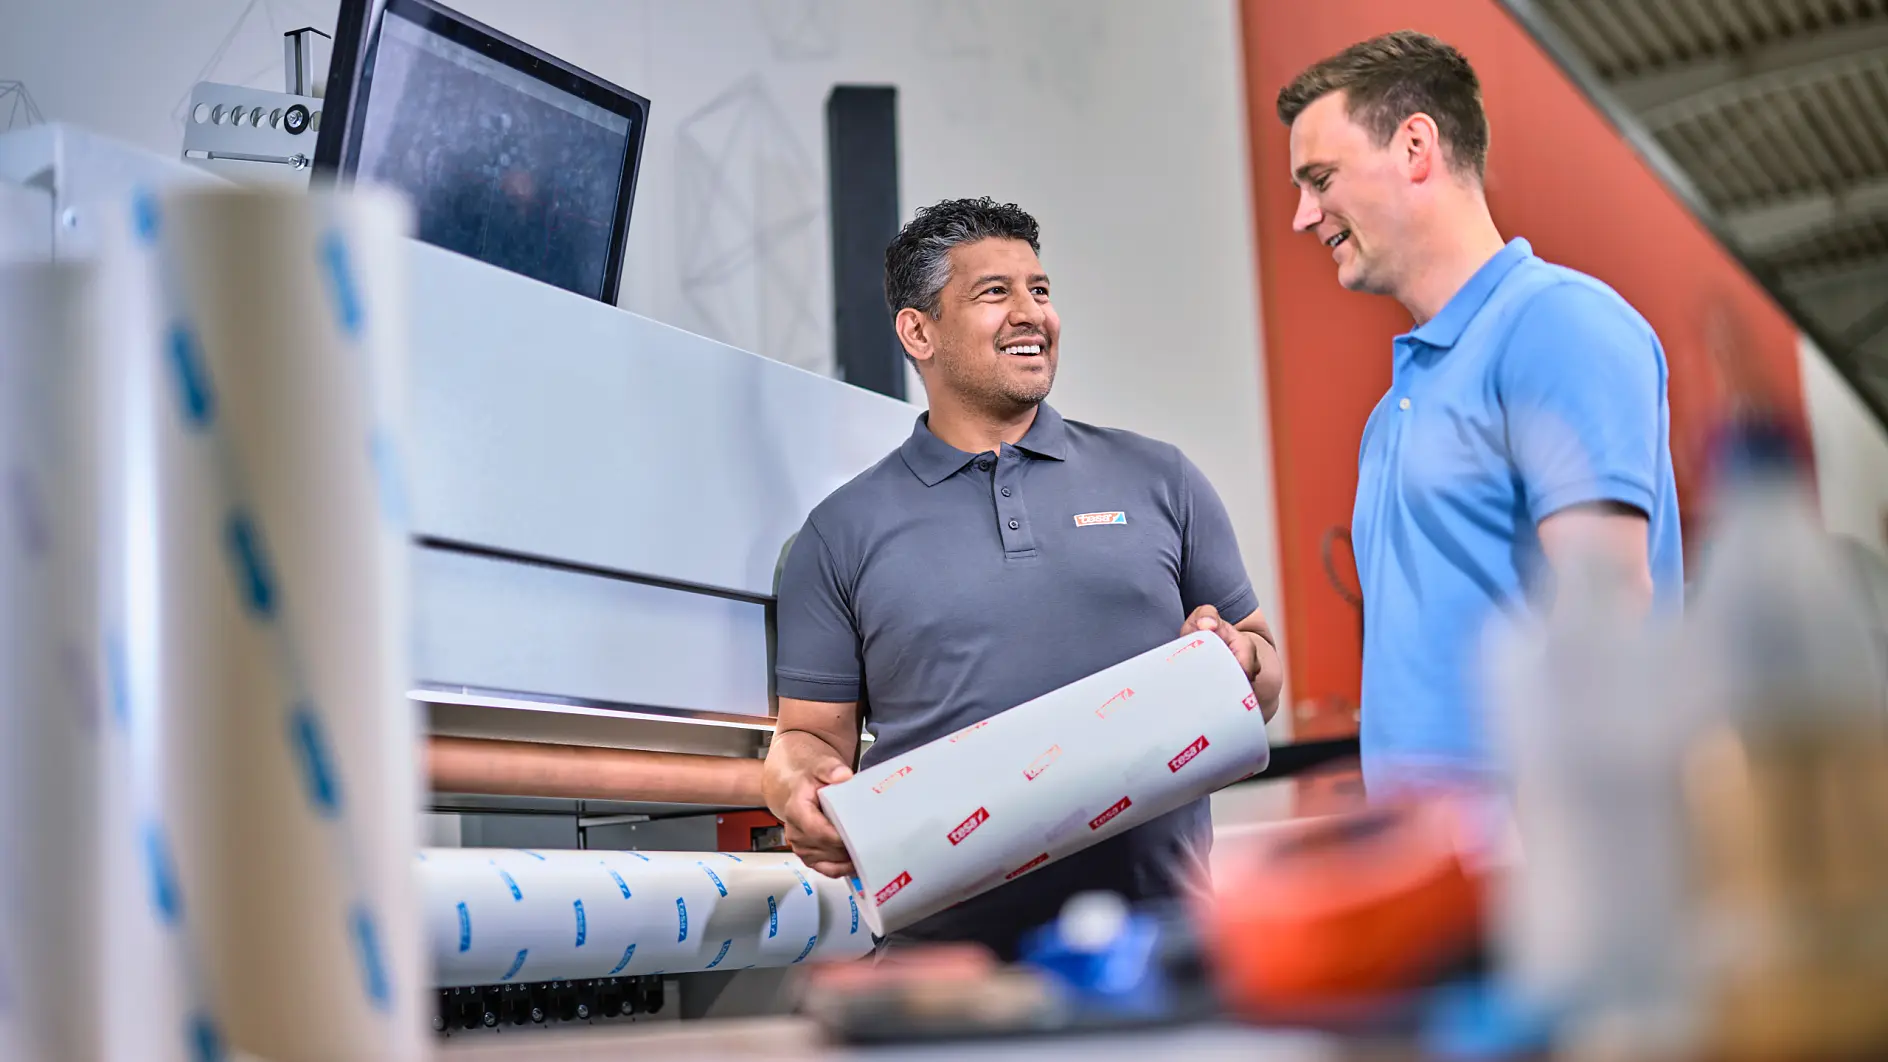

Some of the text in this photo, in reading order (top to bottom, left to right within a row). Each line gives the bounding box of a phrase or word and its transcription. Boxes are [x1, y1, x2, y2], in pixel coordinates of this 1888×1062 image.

[1079, 513, 1113, 524] tesa
[1170, 744, 1198, 770] tesa
[1093, 806, 1119, 827] tesa
[950, 816, 979, 843] tesa
